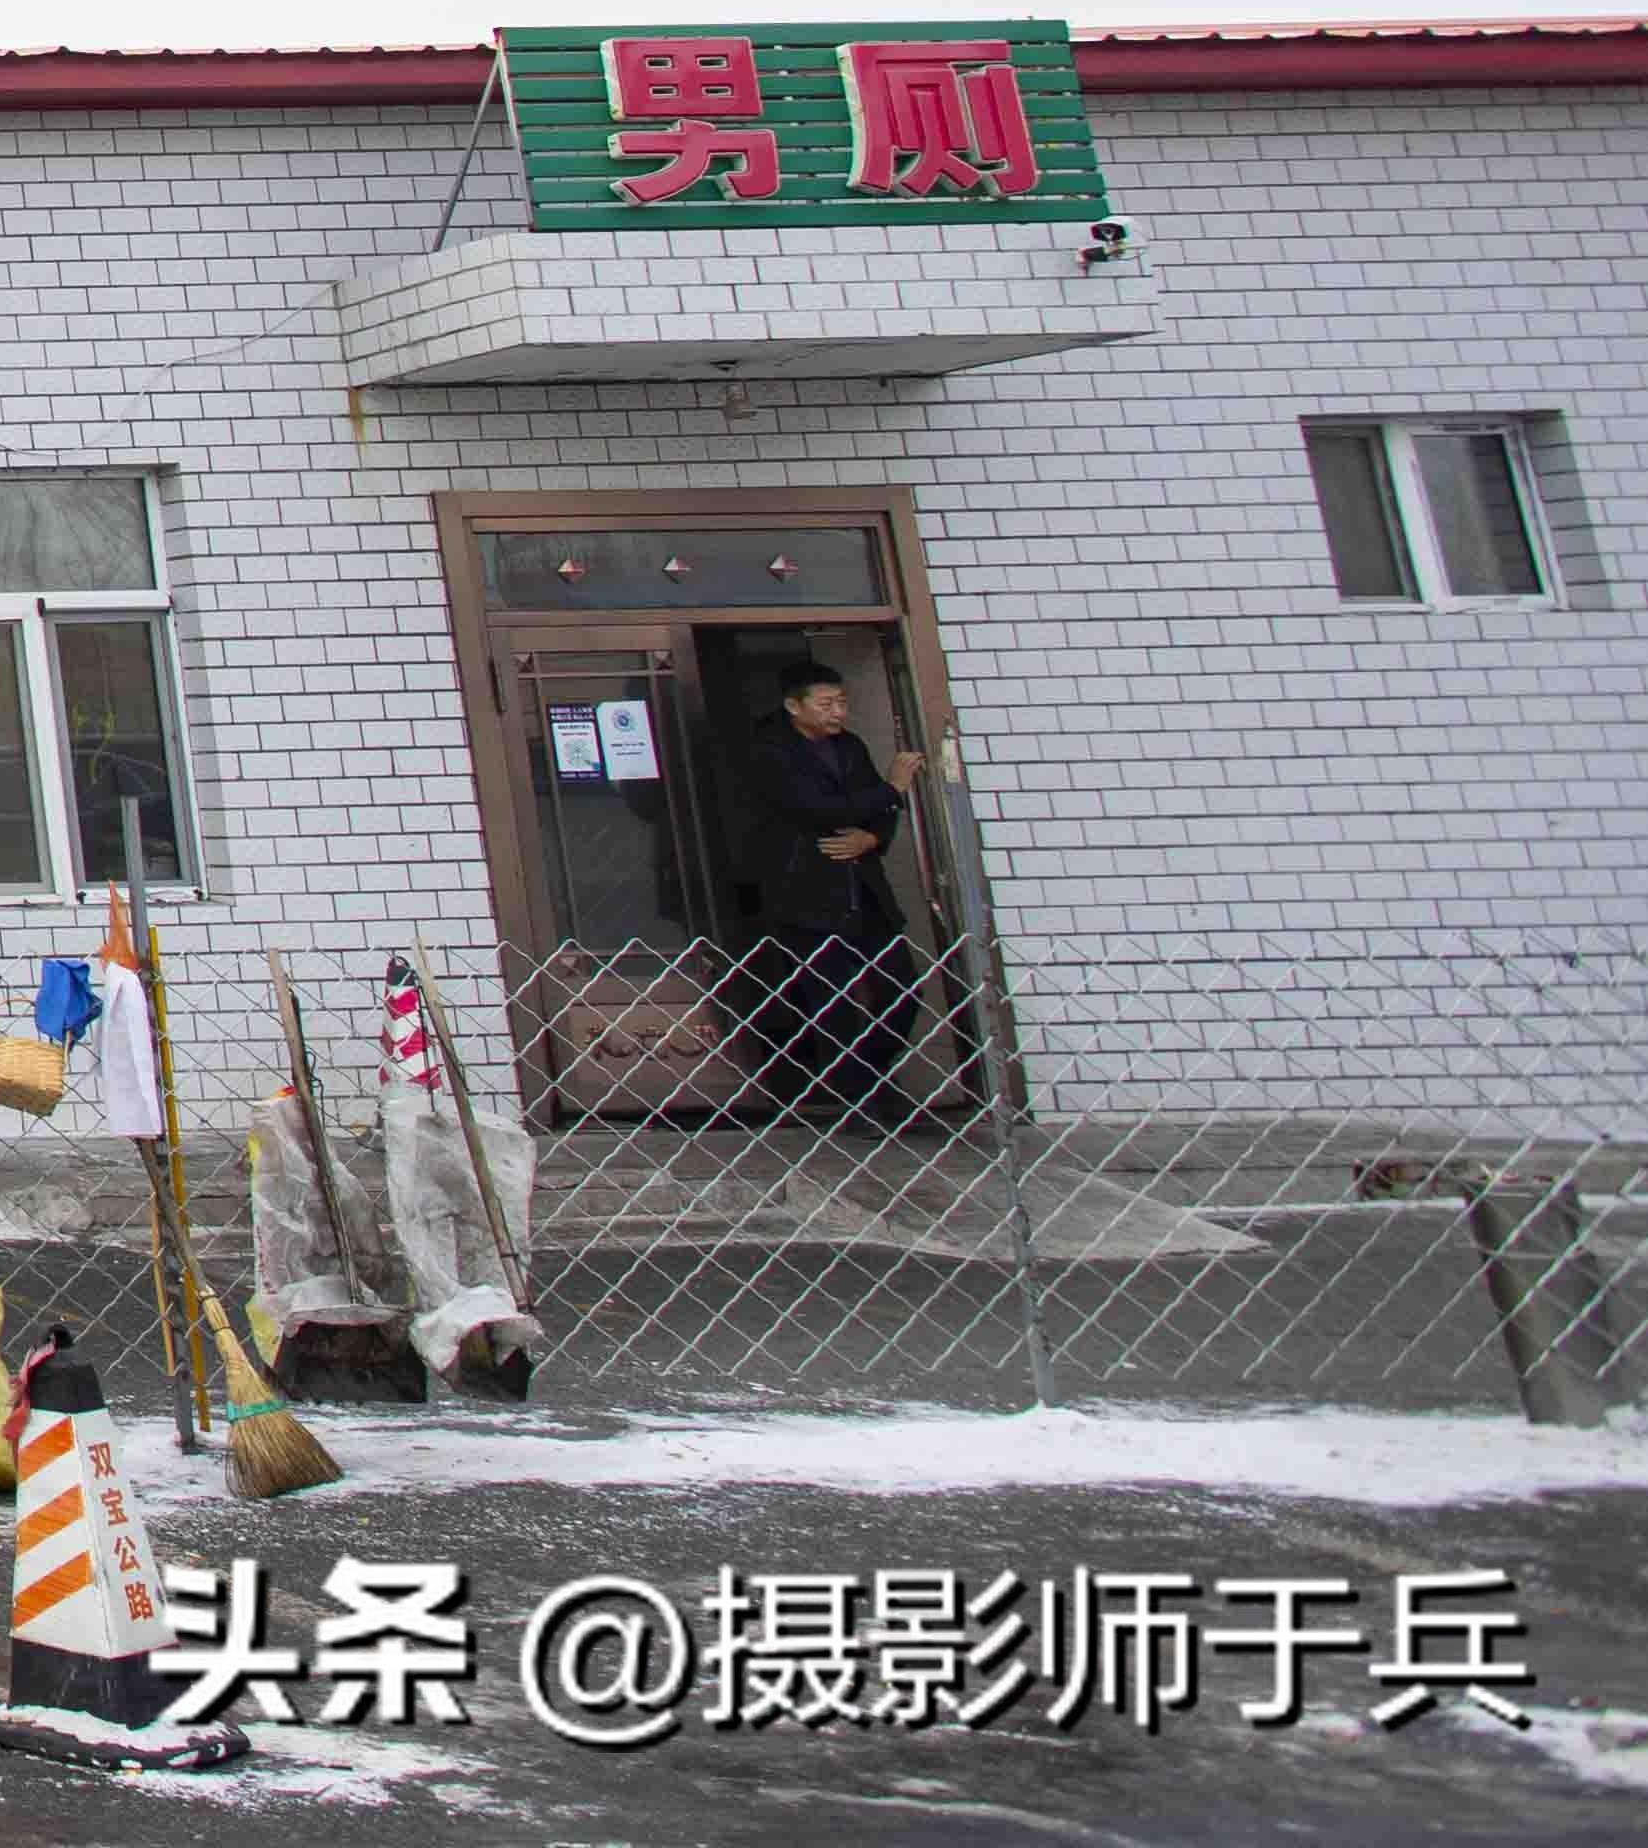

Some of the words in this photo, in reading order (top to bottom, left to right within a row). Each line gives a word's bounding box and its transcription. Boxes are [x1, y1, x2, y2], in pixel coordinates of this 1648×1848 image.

[601, 37, 1041, 205] 男厕
[88, 1442, 155, 1621] 双宝公路
